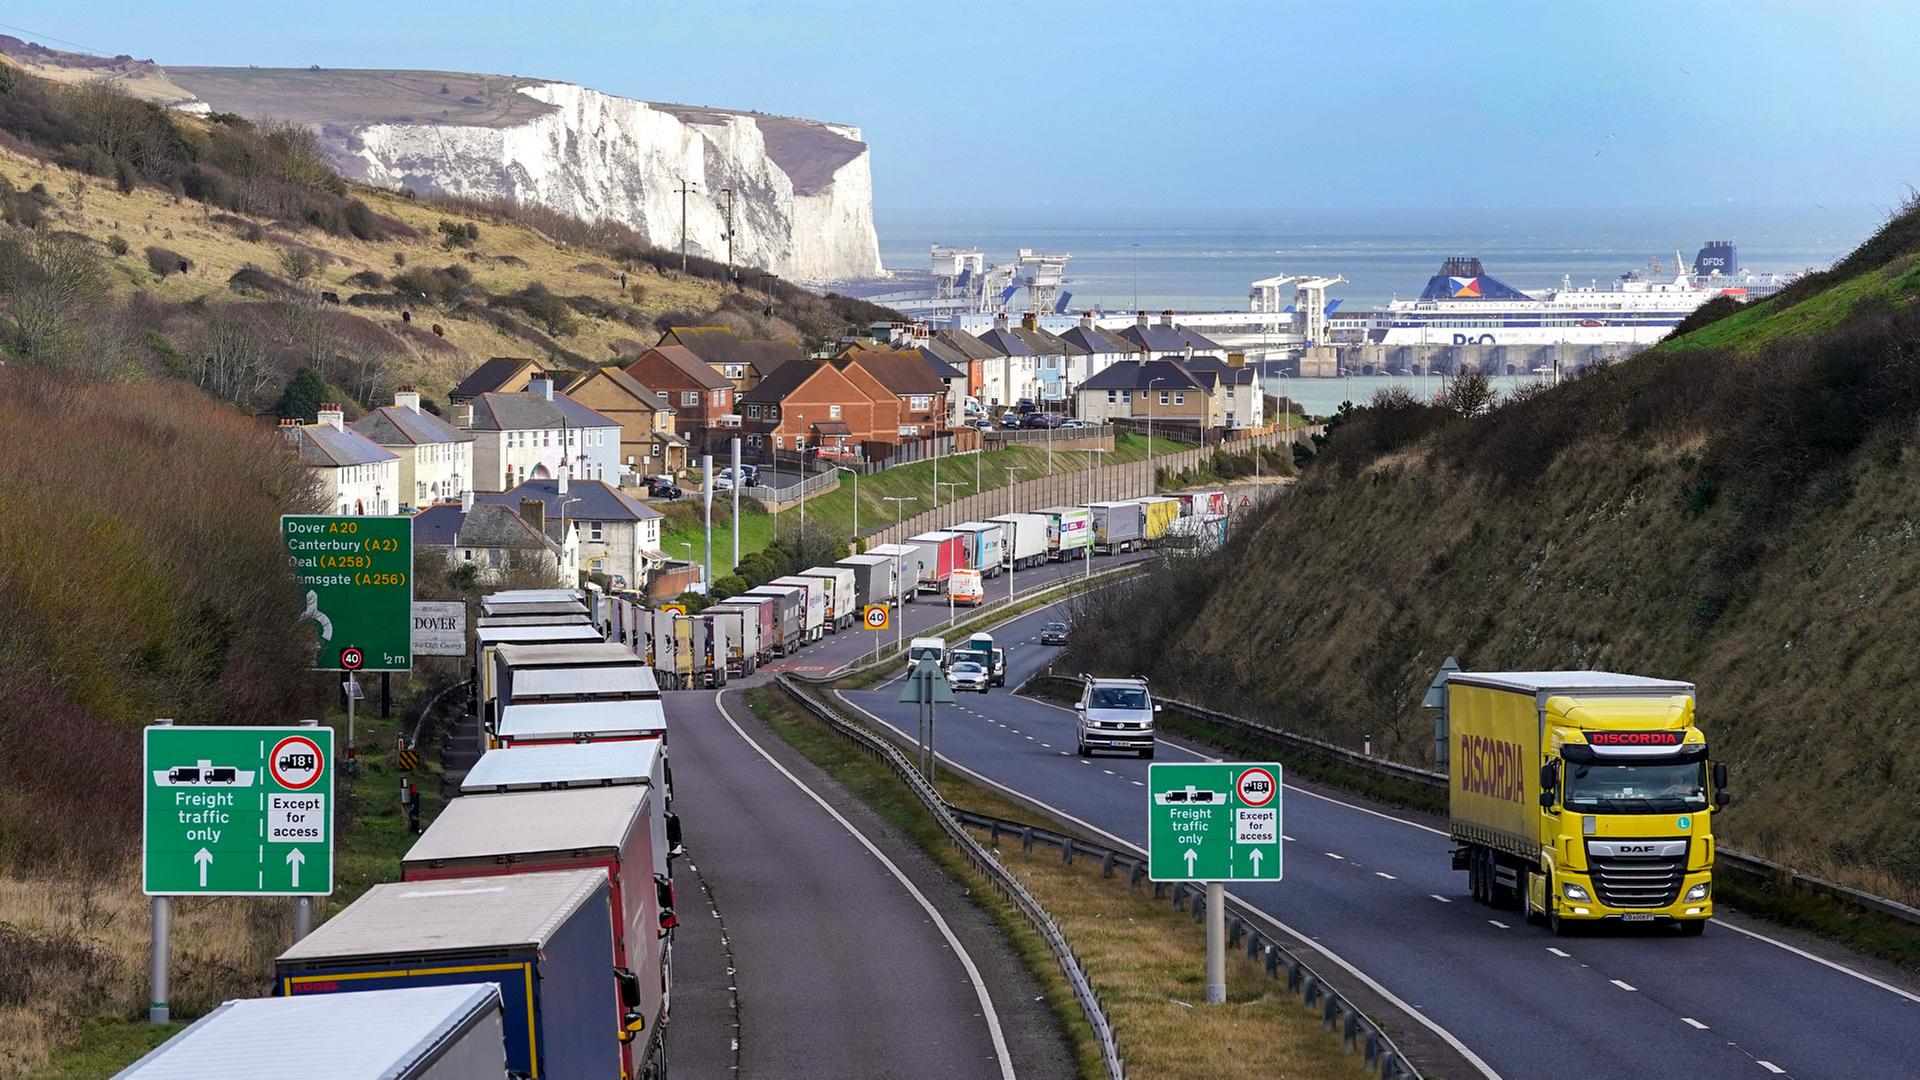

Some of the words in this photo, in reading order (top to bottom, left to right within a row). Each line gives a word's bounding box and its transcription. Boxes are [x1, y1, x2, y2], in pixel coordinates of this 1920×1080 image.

[1702, 257, 1725, 266] DFDS
[288, 522, 325, 533] Dover
[330, 522, 357, 534] A20
[288, 538, 360, 552] Canterbury
[364, 538, 398, 552] (A2)
[320, 555, 371, 569] (A258)
[355, 572, 405, 586] (A256)
[869, 612, 884, 622] 40
[415, 617, 456, 630] DOVER
[345, 654, 359, 663] 40
[1593, 733, 1677, 744] DISCORDIA
[1461, 734, 1525, 805] DISCORDIA
[175, 792, 233, 809] Freight
[273, 798, 320, 812] Except
[178, 810, 230, 824] traffic
[286, 811, 305, 823] for
[1170, 808, 1212, 821] Freight
[1240, 811, 1273, 822] Except
[1172, 821, 1209, 831] traffic
[1249, 821, 1263, 830] for
[186, 827, 221, 843] only
[273, 827, 318, 837] access
[1240, 832, 1272, 840] access
[1178, 833, 1203, 845] only
[1620, 845, 1655, 853] DAF
